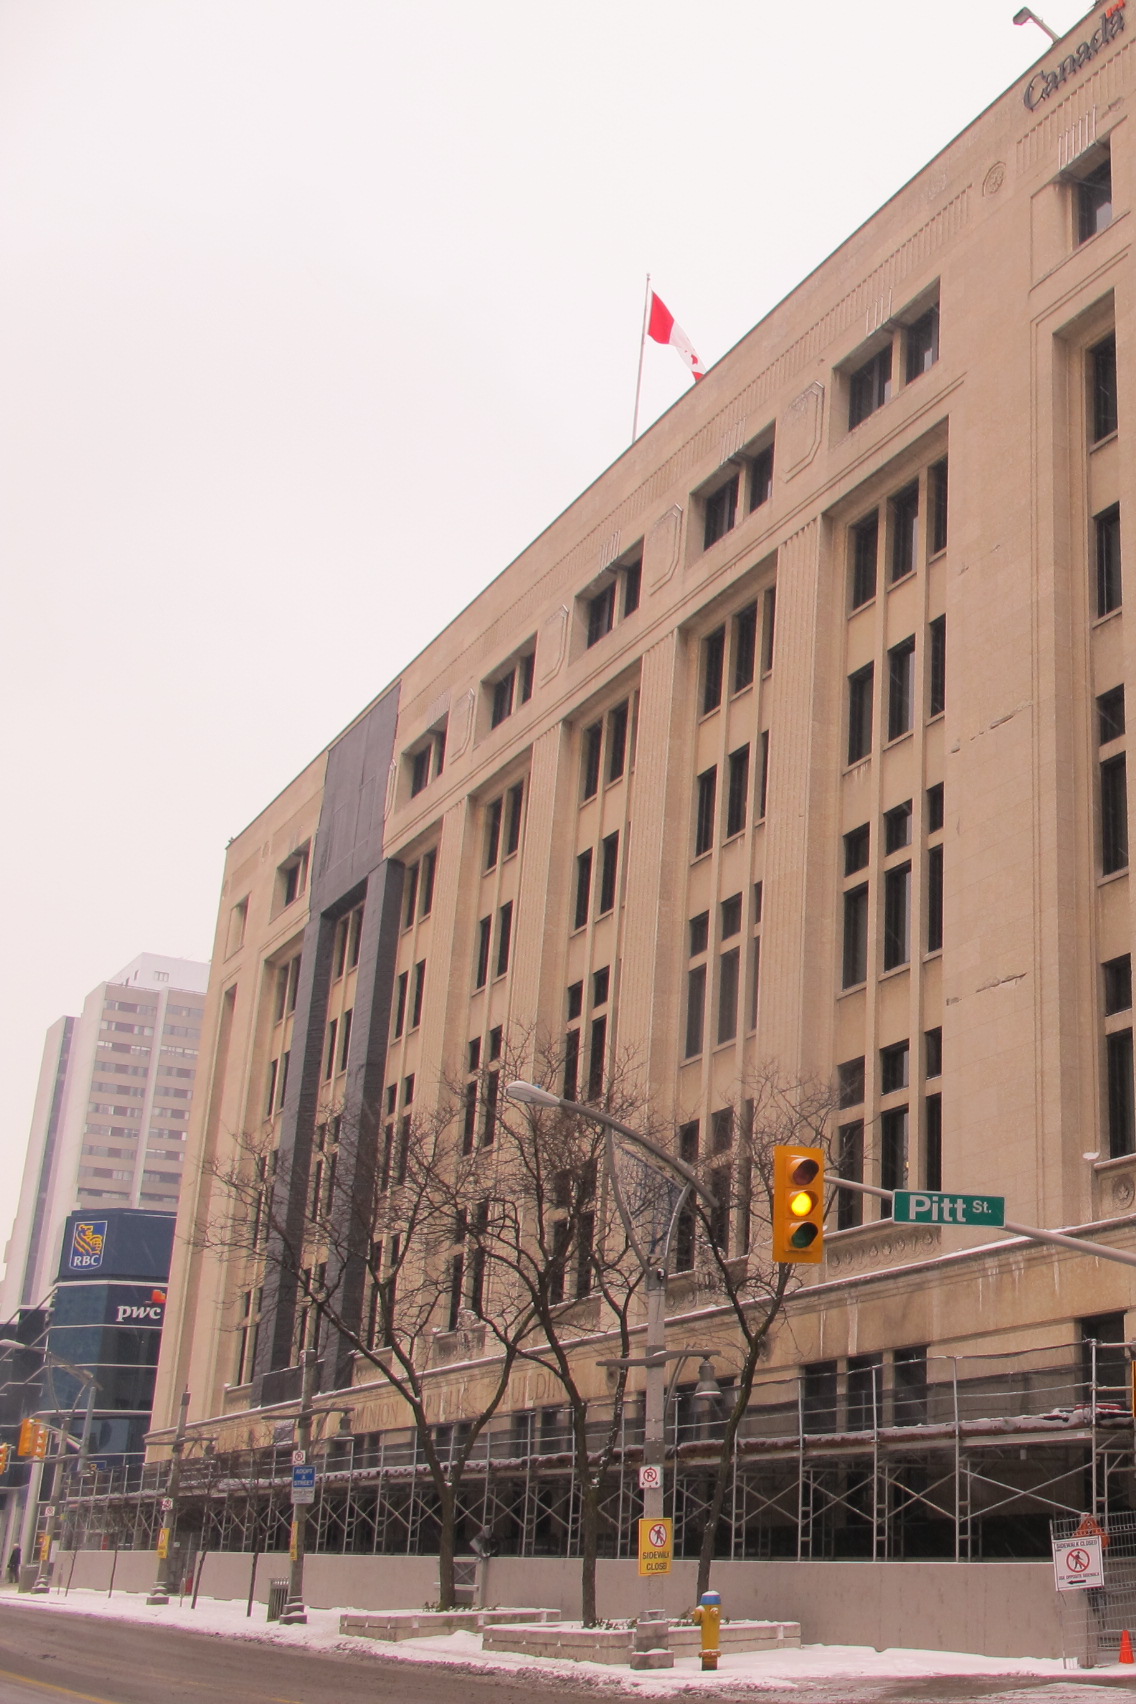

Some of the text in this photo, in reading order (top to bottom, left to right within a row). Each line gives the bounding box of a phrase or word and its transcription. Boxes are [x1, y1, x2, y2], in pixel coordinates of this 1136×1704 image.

[1023, 9, 1125, 112] Canada
[909, 1195, 992, 1222] Pitt St.
[73, 1255, 99, 1267] RBC
[115, 1305, 161, 1322] pwc
